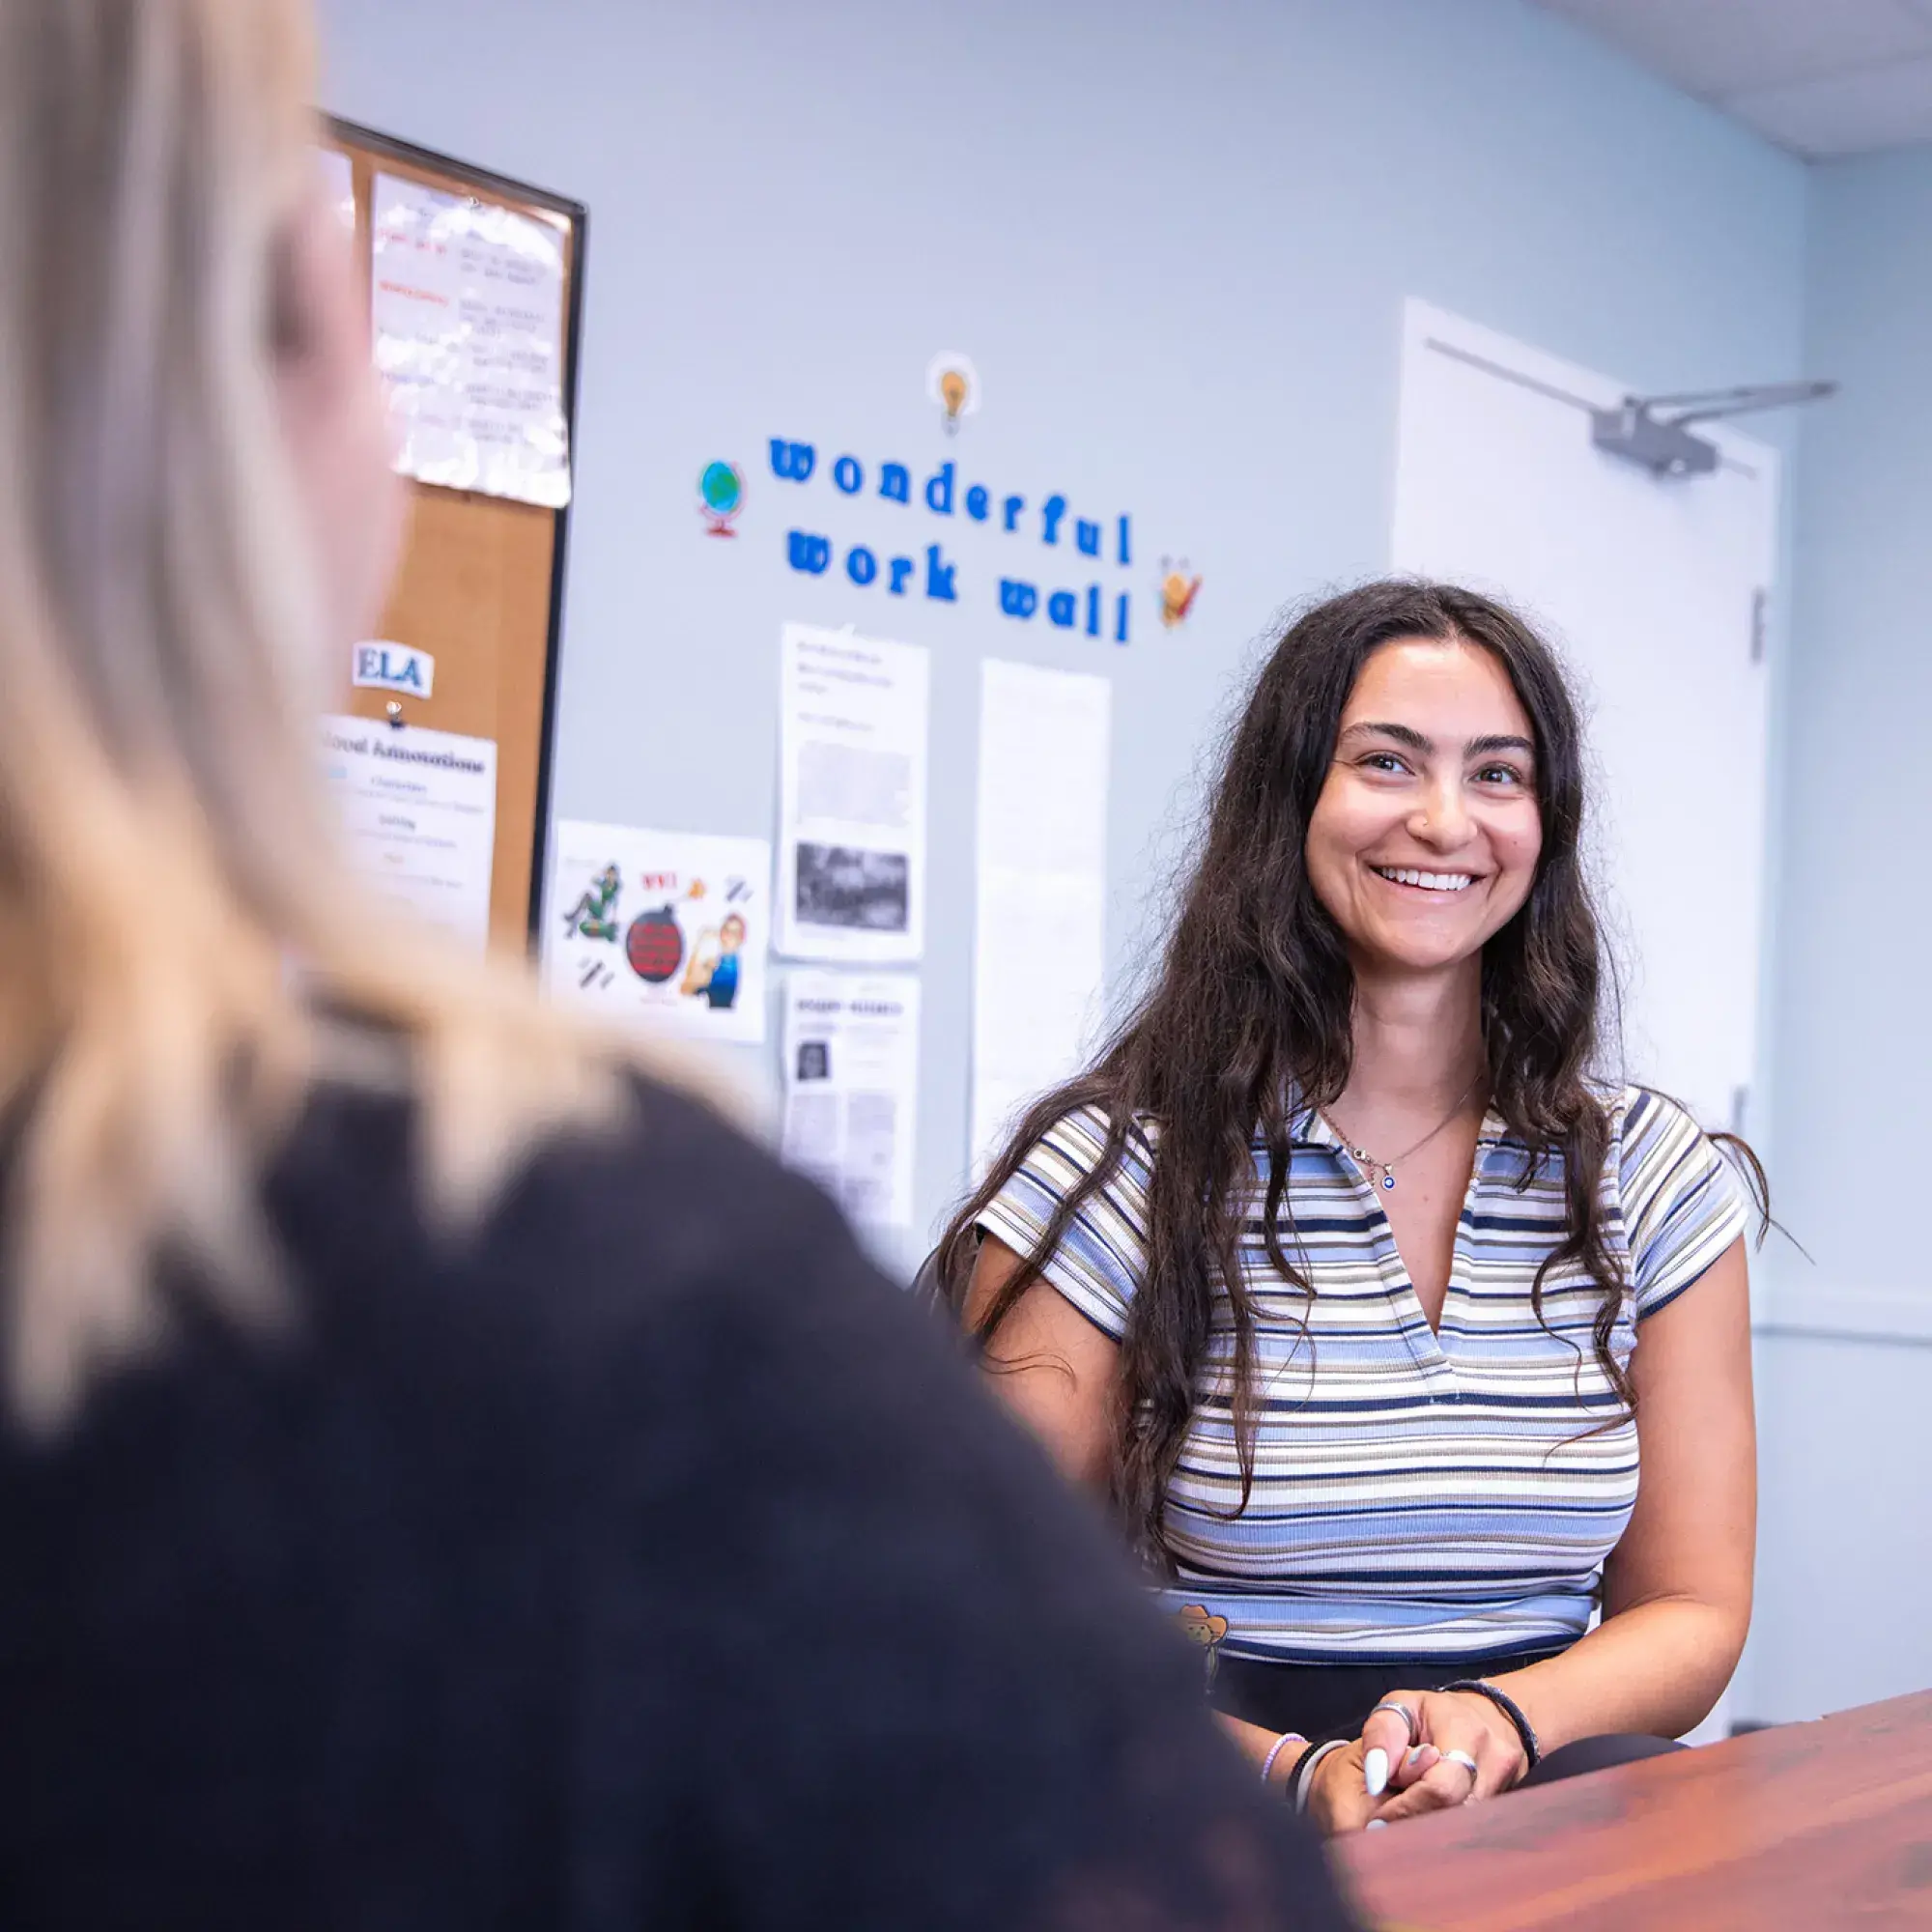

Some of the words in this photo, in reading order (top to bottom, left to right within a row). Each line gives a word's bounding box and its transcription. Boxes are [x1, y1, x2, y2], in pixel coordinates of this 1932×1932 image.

[769, 437, 1131, 565] wonderful
[786, 528, 957, 603] work
[998, 578, 1129, 644] wall
[358, 647, 422, 688] ELA
[323, 731, 368, 754] ood
